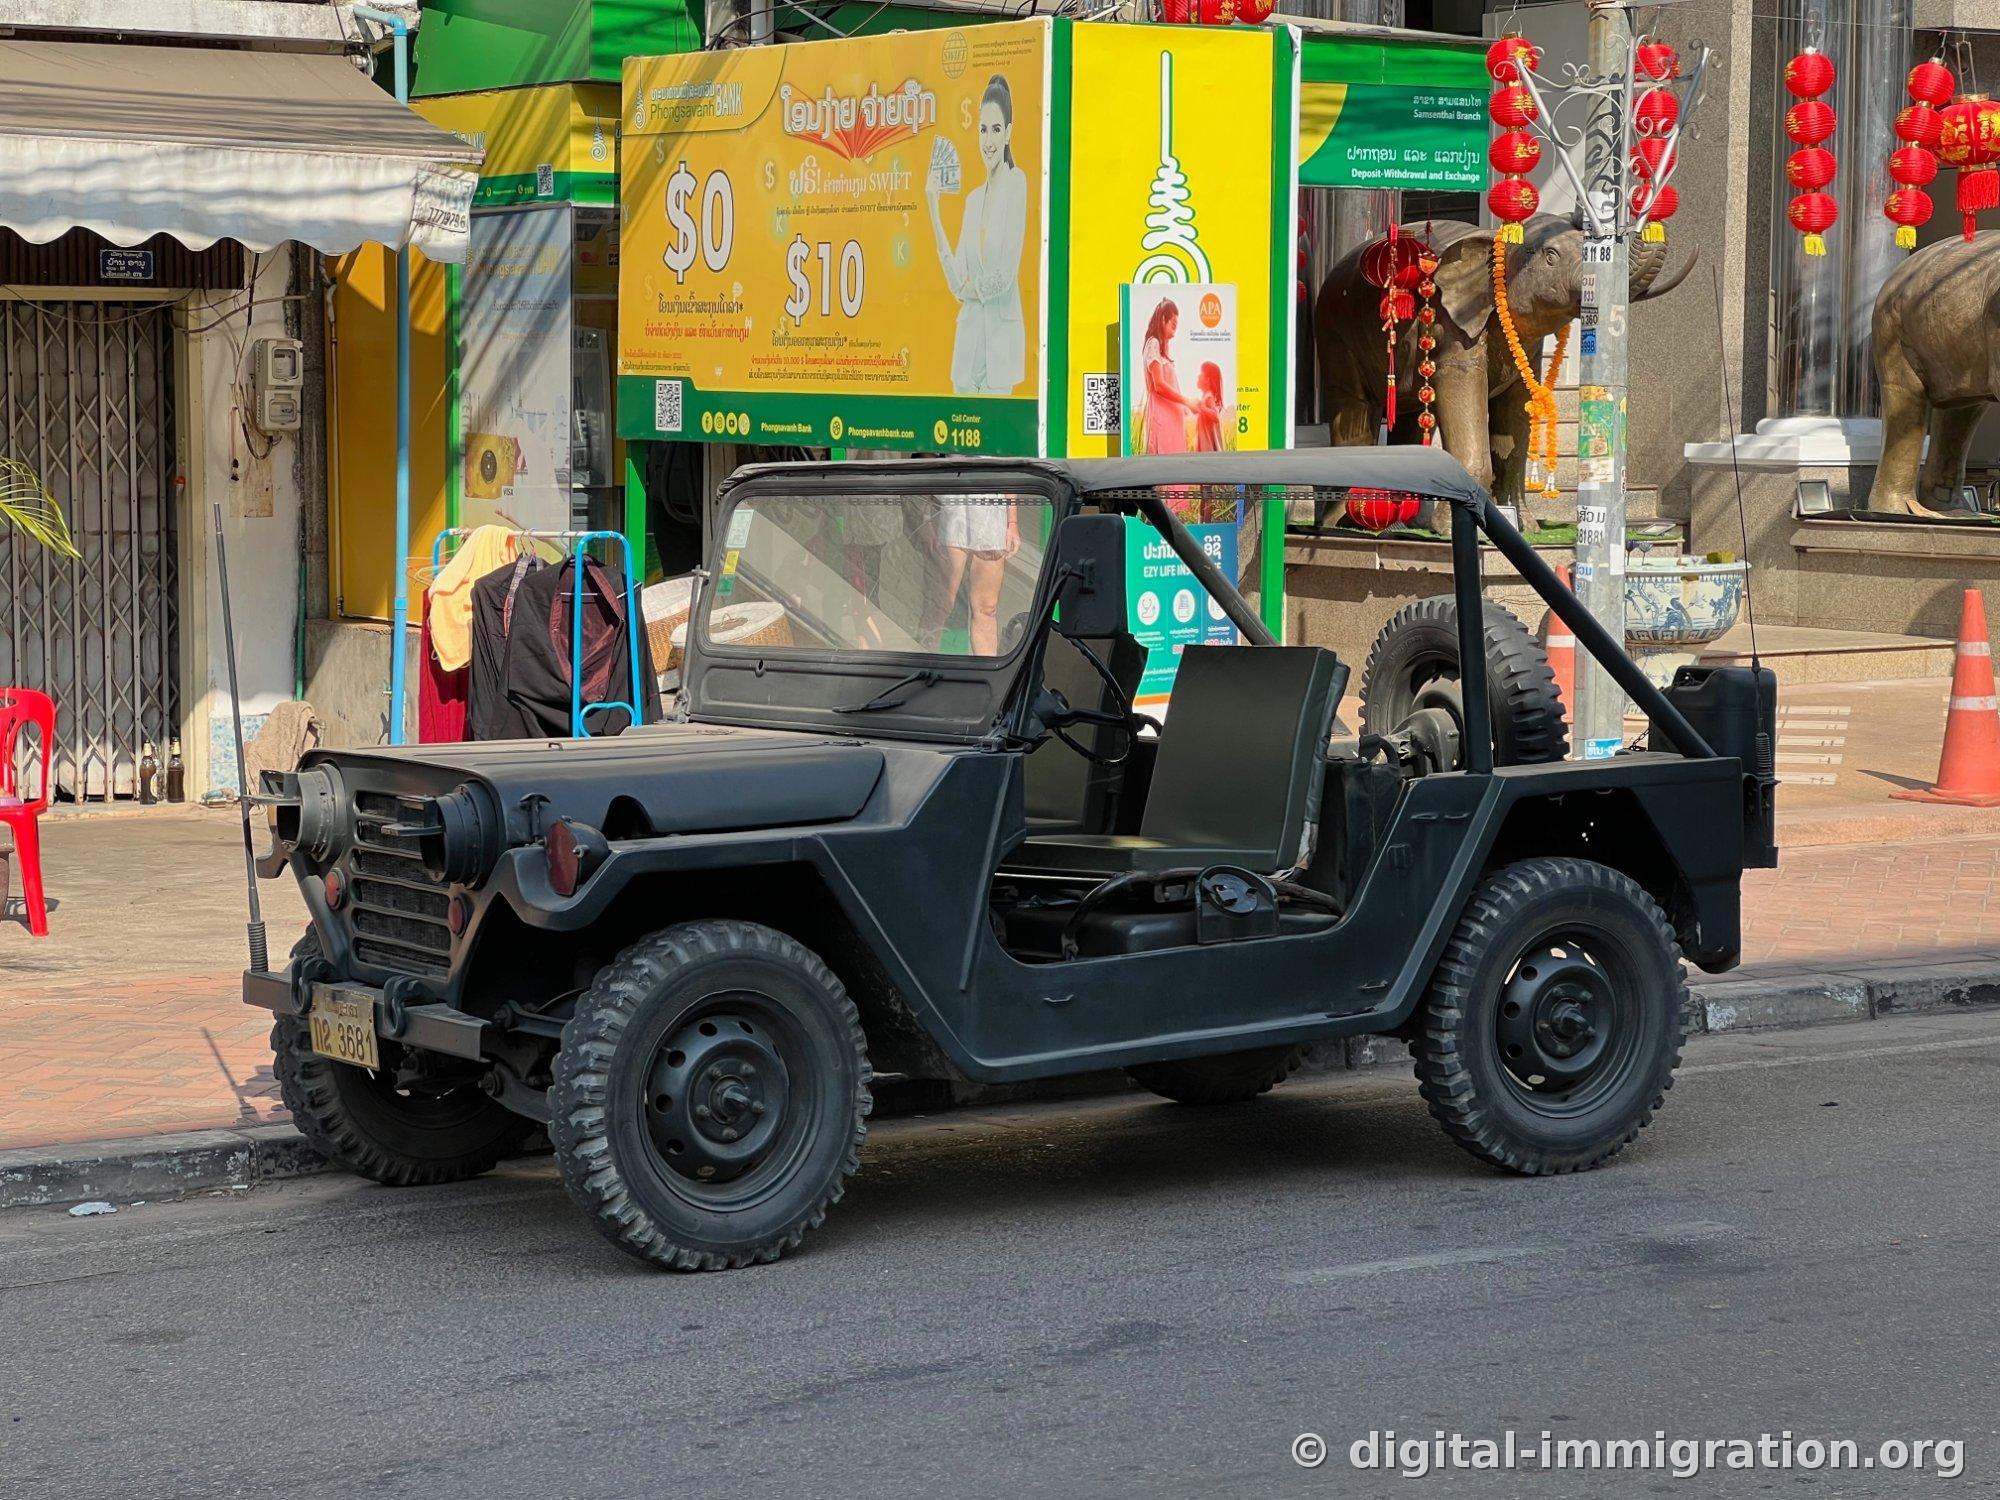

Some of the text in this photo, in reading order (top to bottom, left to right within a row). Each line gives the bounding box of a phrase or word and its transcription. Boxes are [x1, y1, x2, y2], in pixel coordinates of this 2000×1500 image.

[715, 82, 744, 117] BANK
[650, 103, 714, 122] Phongsavanh
[1414, 109, 1481, 121] Samsenthai Branch
[1404, 149, 1427, 162] ແລະ
[868, 170, 912, 192] SWIFT
[1351, 168, 1480, 184] Deposit-Withdrawal and Exchange
[662, 160, 735, 285] $0
[1600, 246, 1611, 262] 88
[784, 233, 865, 327] $10
[1200, 301, 1221, 315] APA
[1608, 304, 1626, 337] 5
[951, 414, 981, 424] Call Center
[761, 422, 812, 434] Phongsavanh Bank
[848, 426, 914, 439] Phongsavanhbank.com
[951, 429, 980, 447] 1188
[502, 487, 514, 497] VISA
[1143, 565, 1158, 578] EZY
[1160, 564, 1176, 577] LIFE
[337, 1022, 374, 1064] 3681
